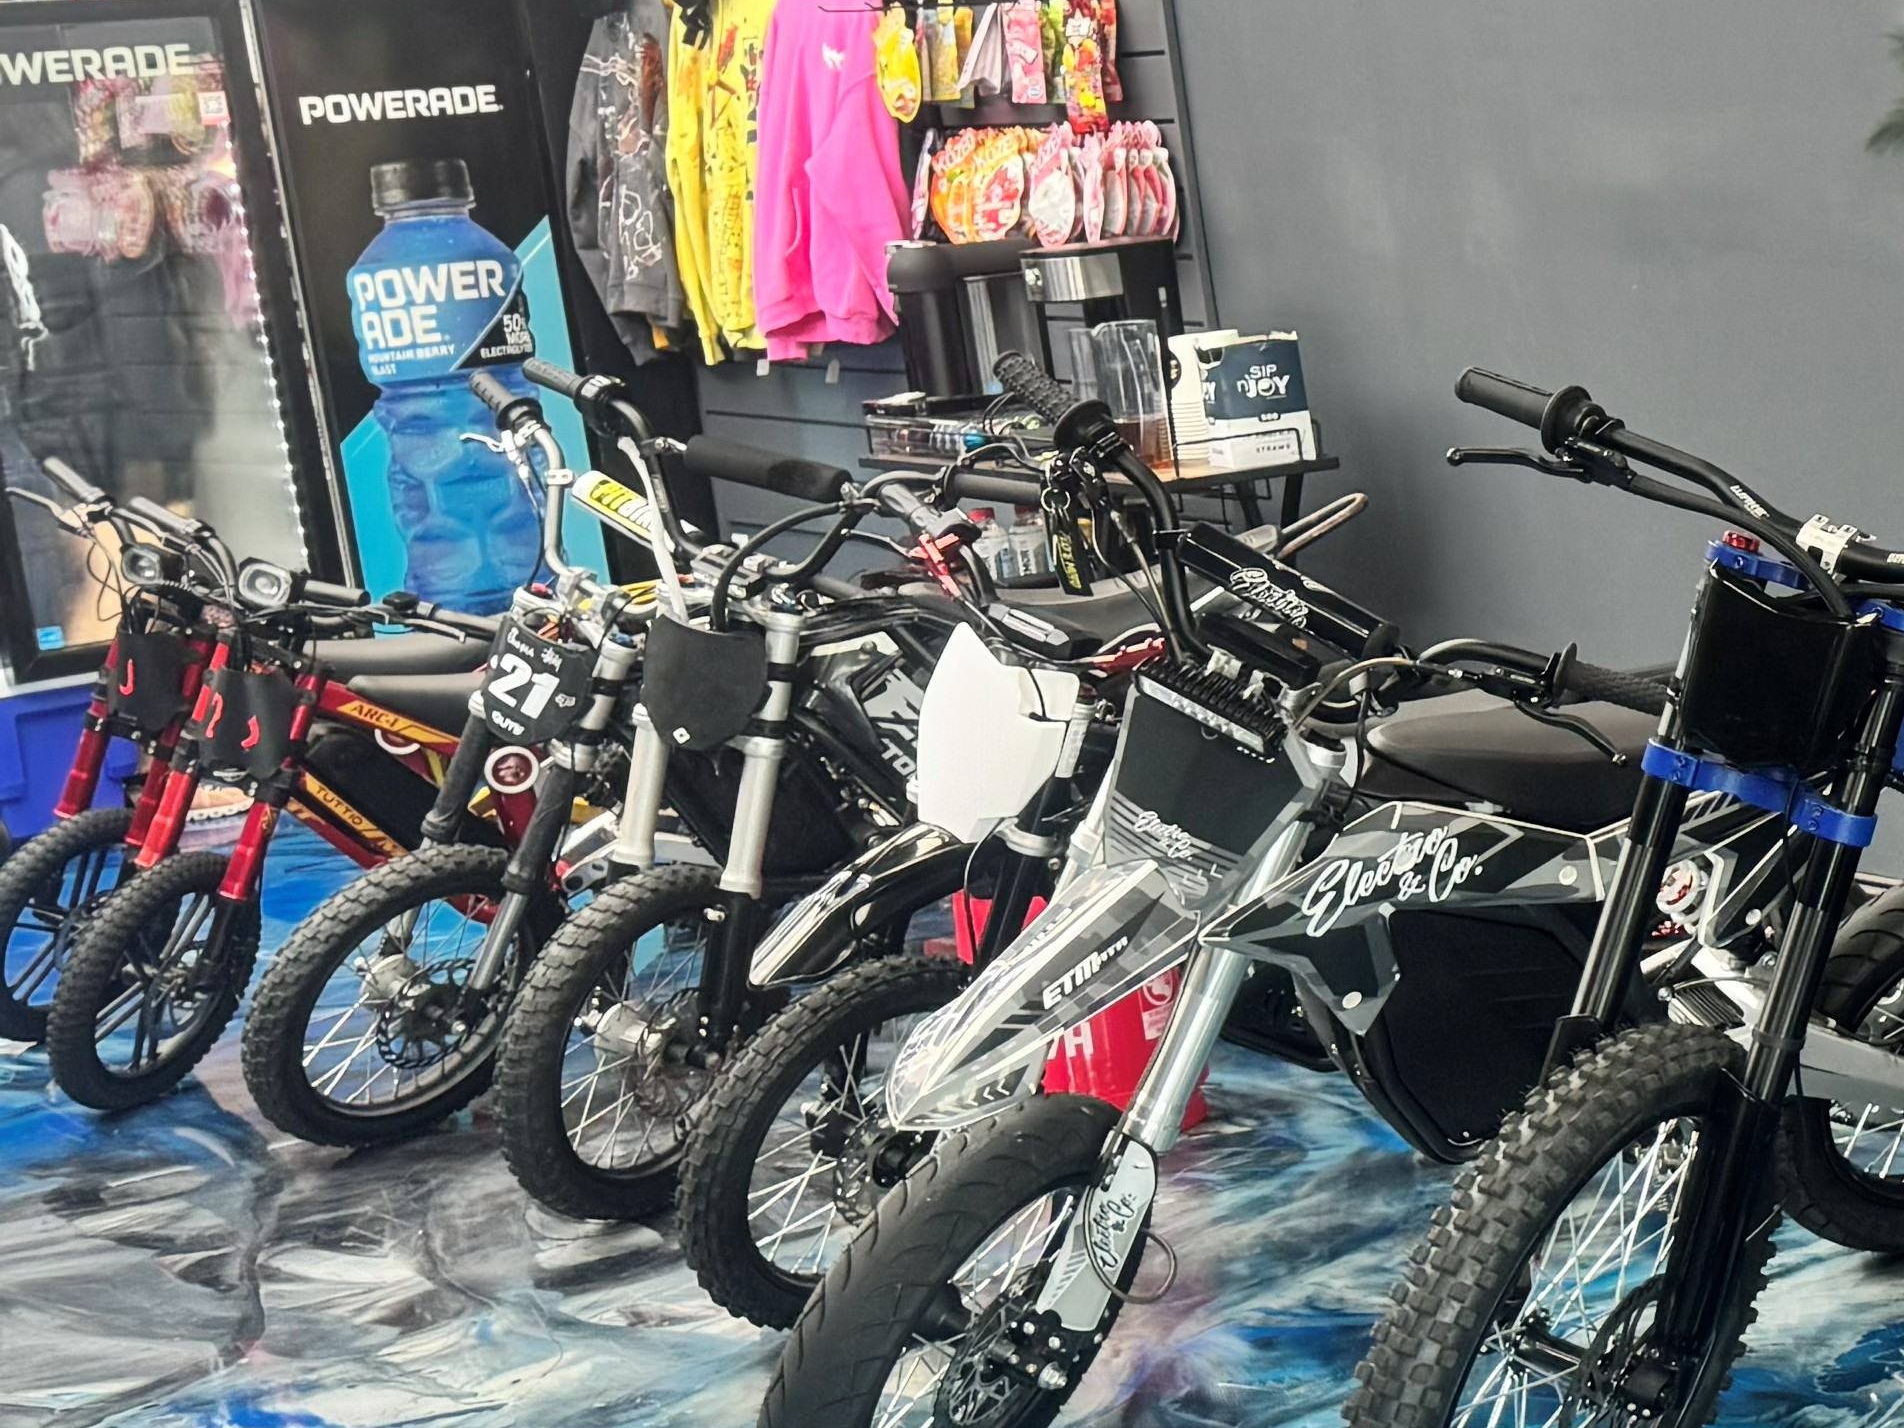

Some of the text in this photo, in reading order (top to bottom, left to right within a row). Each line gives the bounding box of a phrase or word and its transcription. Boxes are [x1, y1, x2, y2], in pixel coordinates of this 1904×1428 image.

[0, 43, 195, 86] WERADE
[298, 85, 499, 125] POWERADE
[353, 259, 506, 311] POWER
[360, 304, 442, 350] ADE
[1249, 364, 1277, 379] SIP
[488, 653, 560, 720] 21
[1428, 837, 1483, 903] Co.
